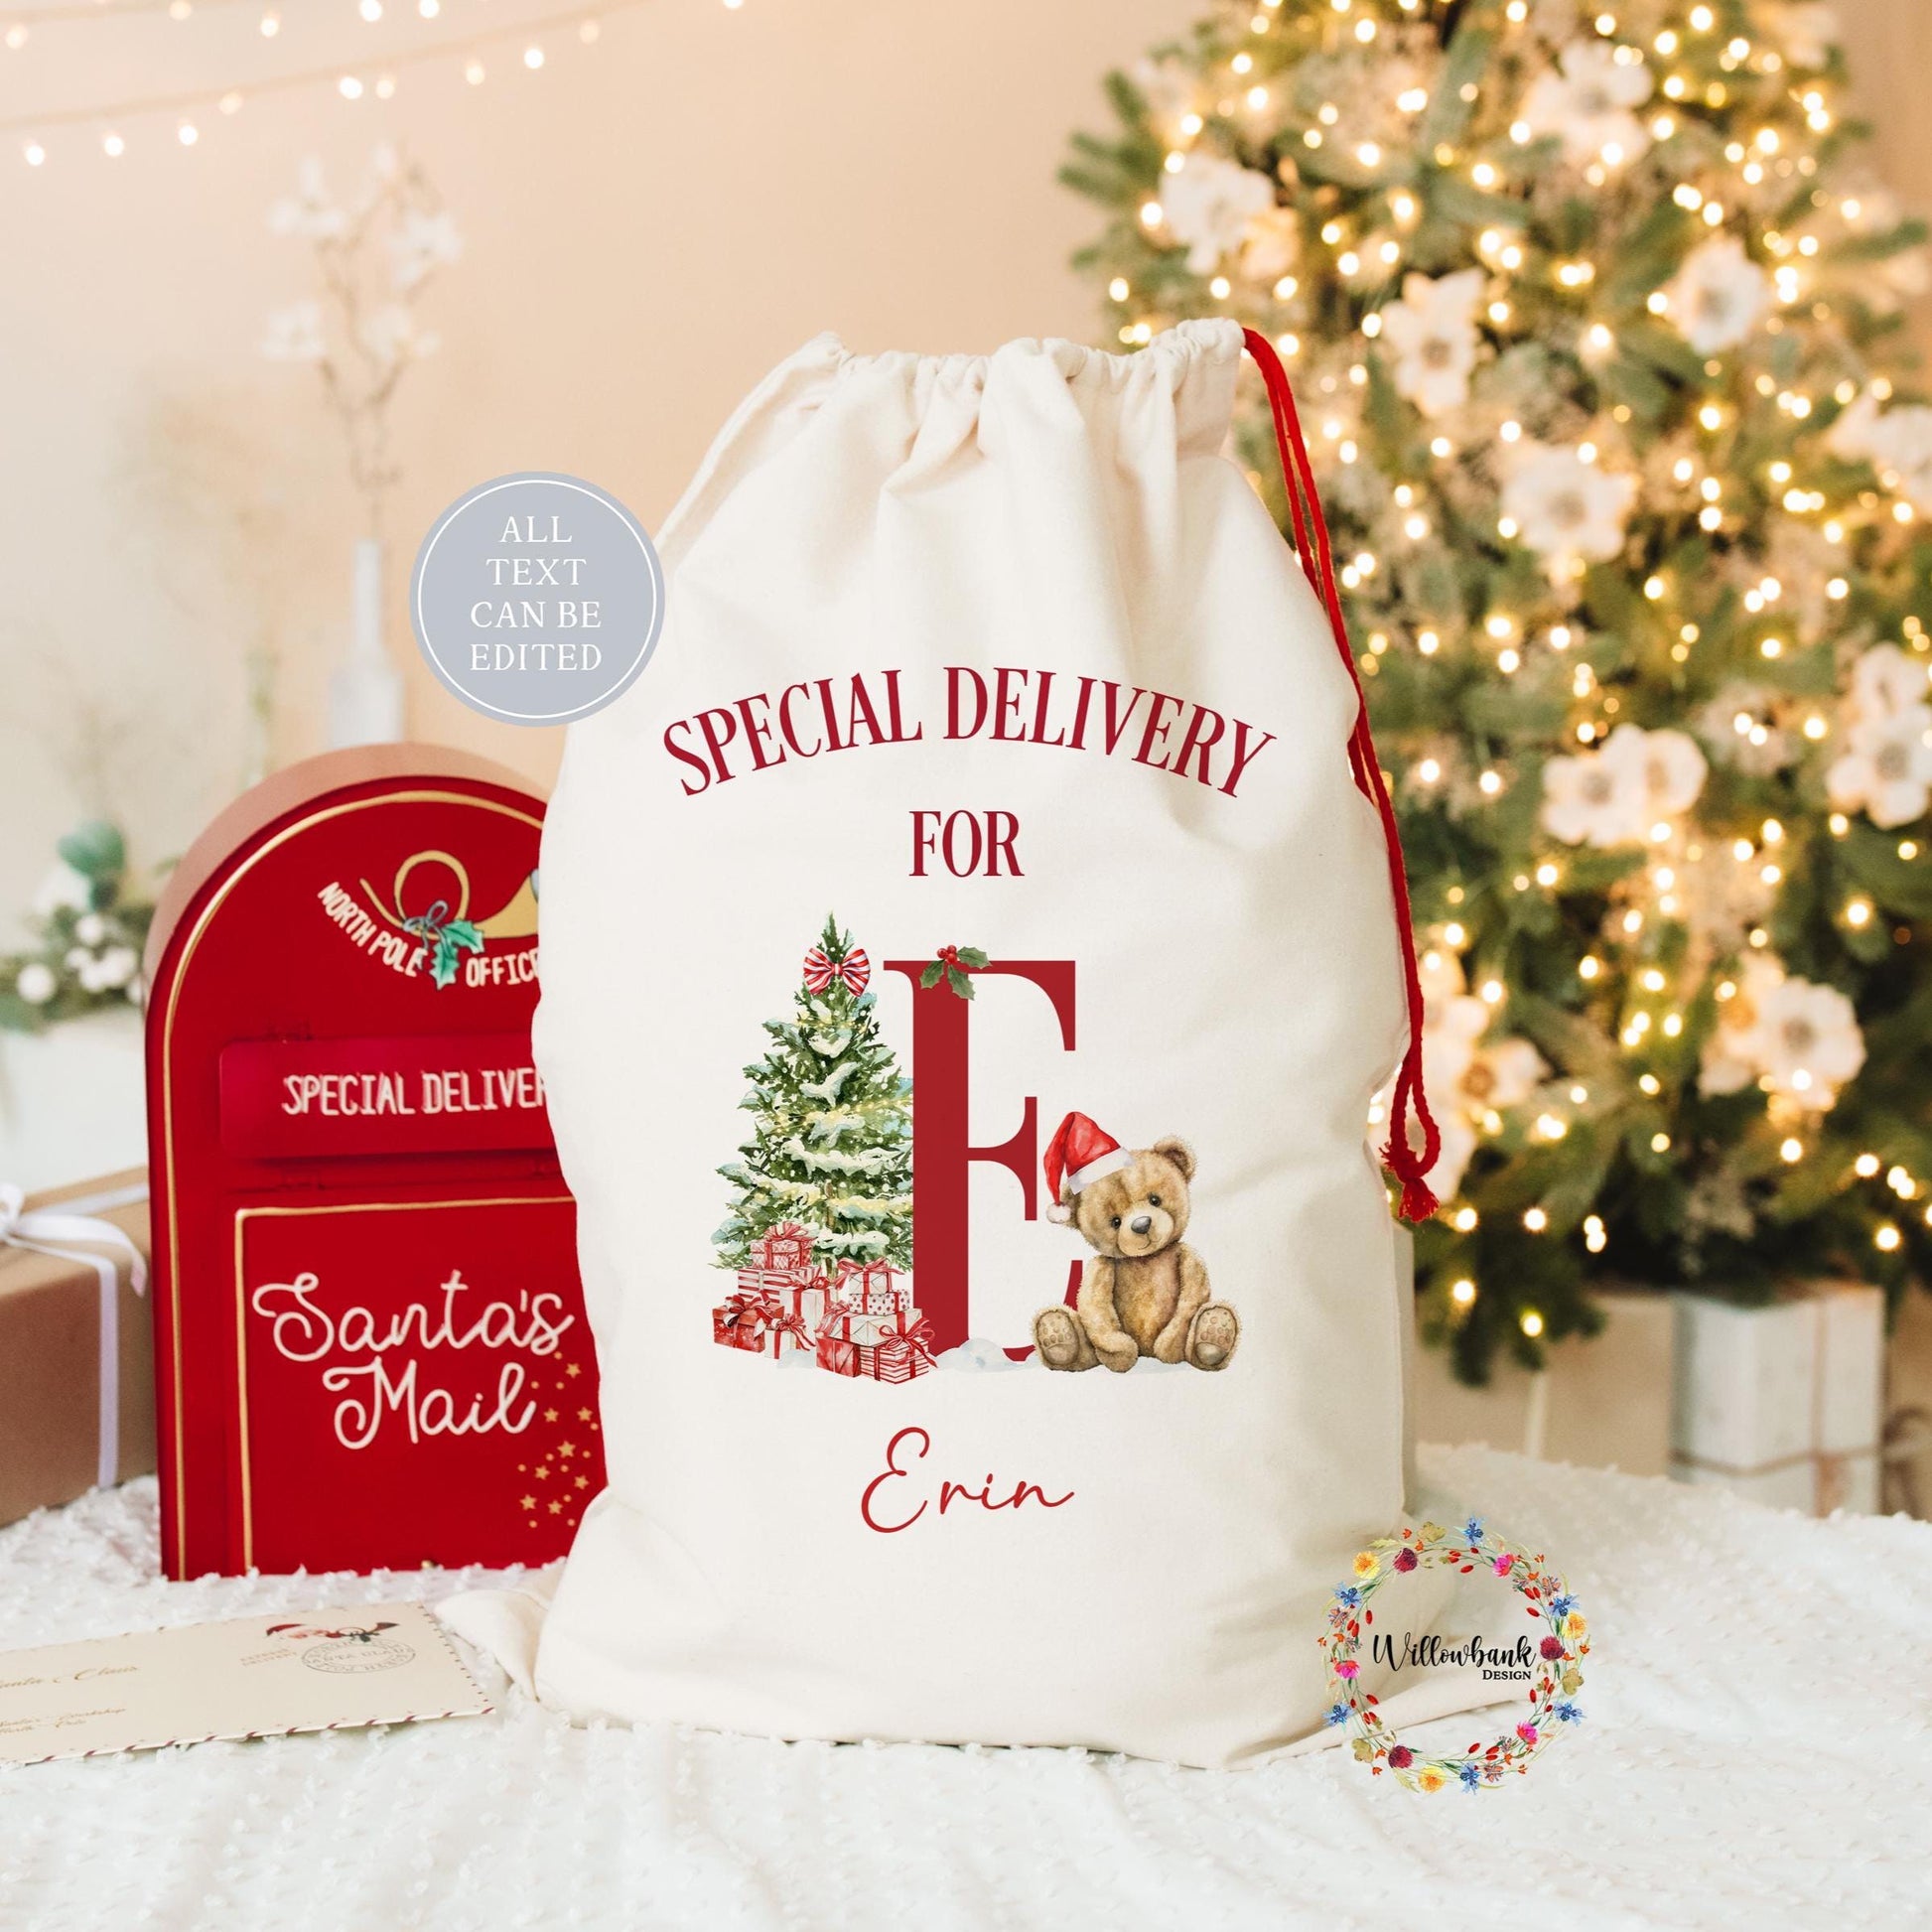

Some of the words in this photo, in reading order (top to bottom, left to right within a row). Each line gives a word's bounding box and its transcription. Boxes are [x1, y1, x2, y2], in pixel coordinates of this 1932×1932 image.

[663, 669, 923, 796] SPECIAL
[942, 666, 1278, 799] DELIVERY
[908, 809, 1026, 878] FOR
[318, 881, 377, 947] NORTH
[367, 930, 428, 977] POLE
[282, 1072, 416, 1116] SPECIAL
[884, 960, 1083, 1363] E
[252, 1269, 575, 1362] Santa's
[323, 1355, 537, 1449] Mail
[861, 1427, 1075, 1534] Erin
